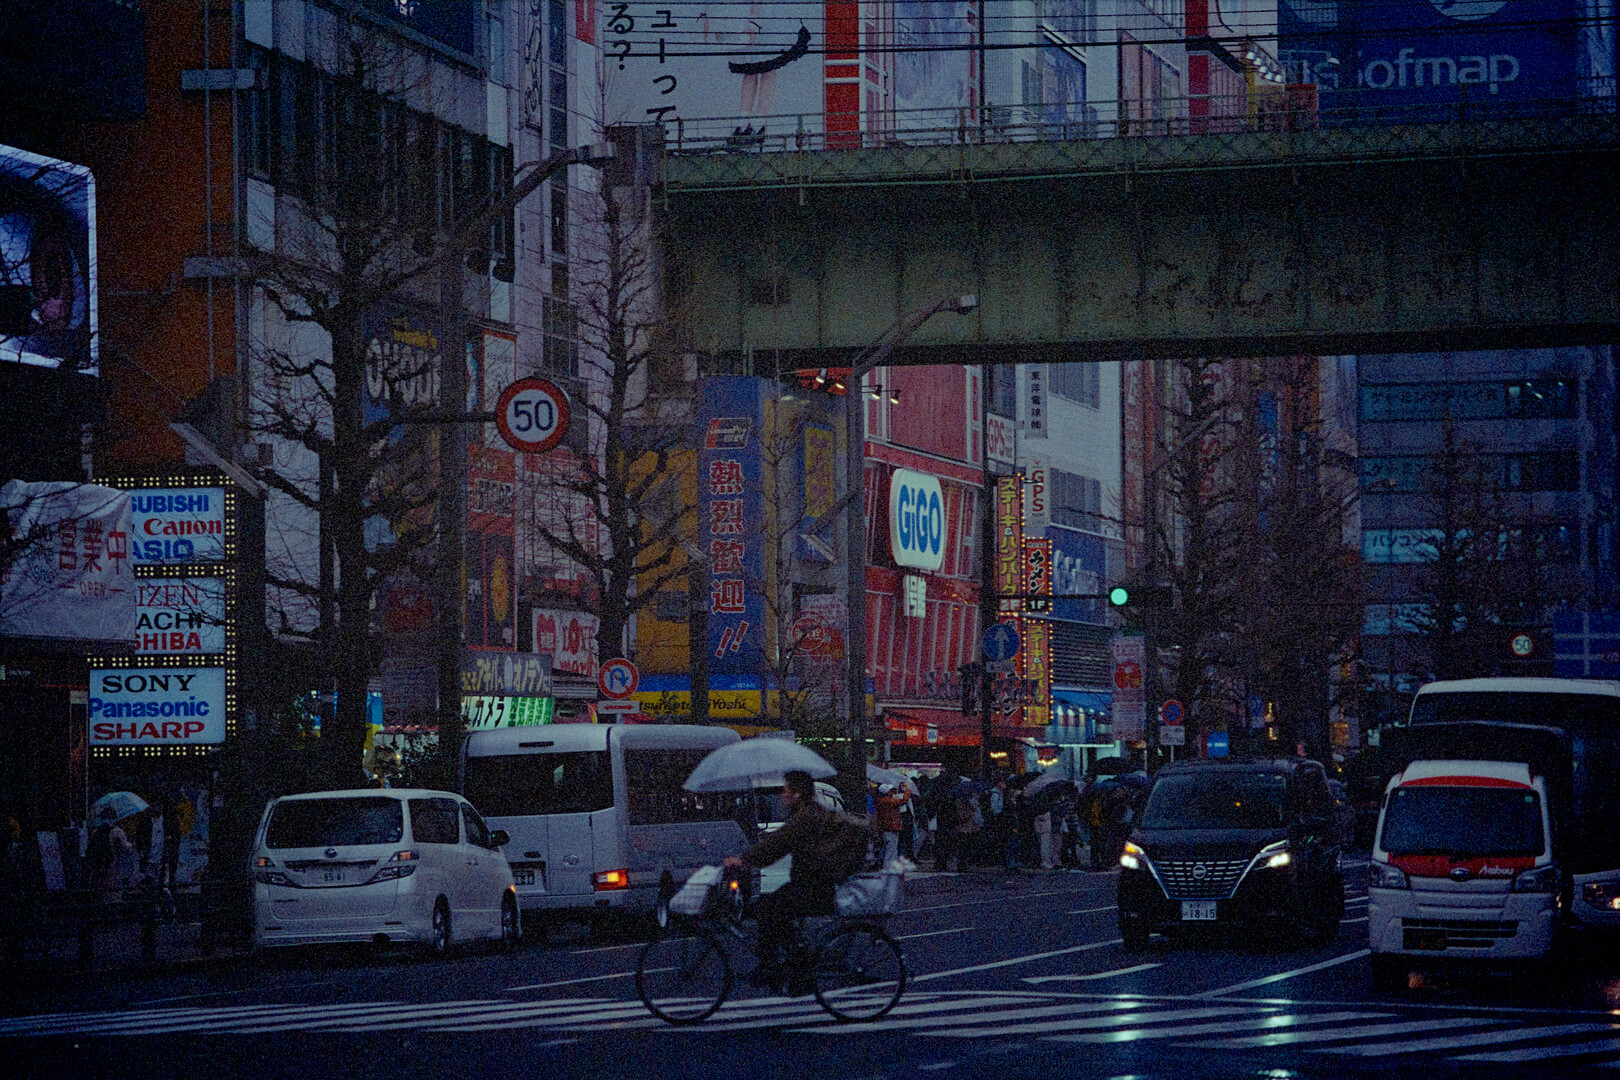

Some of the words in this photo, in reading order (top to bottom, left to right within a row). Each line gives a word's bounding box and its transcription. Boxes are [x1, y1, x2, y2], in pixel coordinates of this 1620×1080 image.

[1357, 48, 1520, 95] ofmap
[514, 400, 553, 432] 50
[988, 418, 1005, 457] GPS
[1031, 470, 1044, 512] GPS
[143, 518, 222, 536] Canon
[898, 484, 941, 555] GiGO
[79, 580, 107, 597] OPEN
[1000, 600, 1020, 611] 2F
[1030, 600, 1046, 610] 1F
[136, 612, 202, 630] ACHI
[1514, 639, 1531, 652] 50
[102, 675, 196, 693] SONY
[88, 696, 210, 718] Panasonic
[93, 721, 205, 740] SHARP
